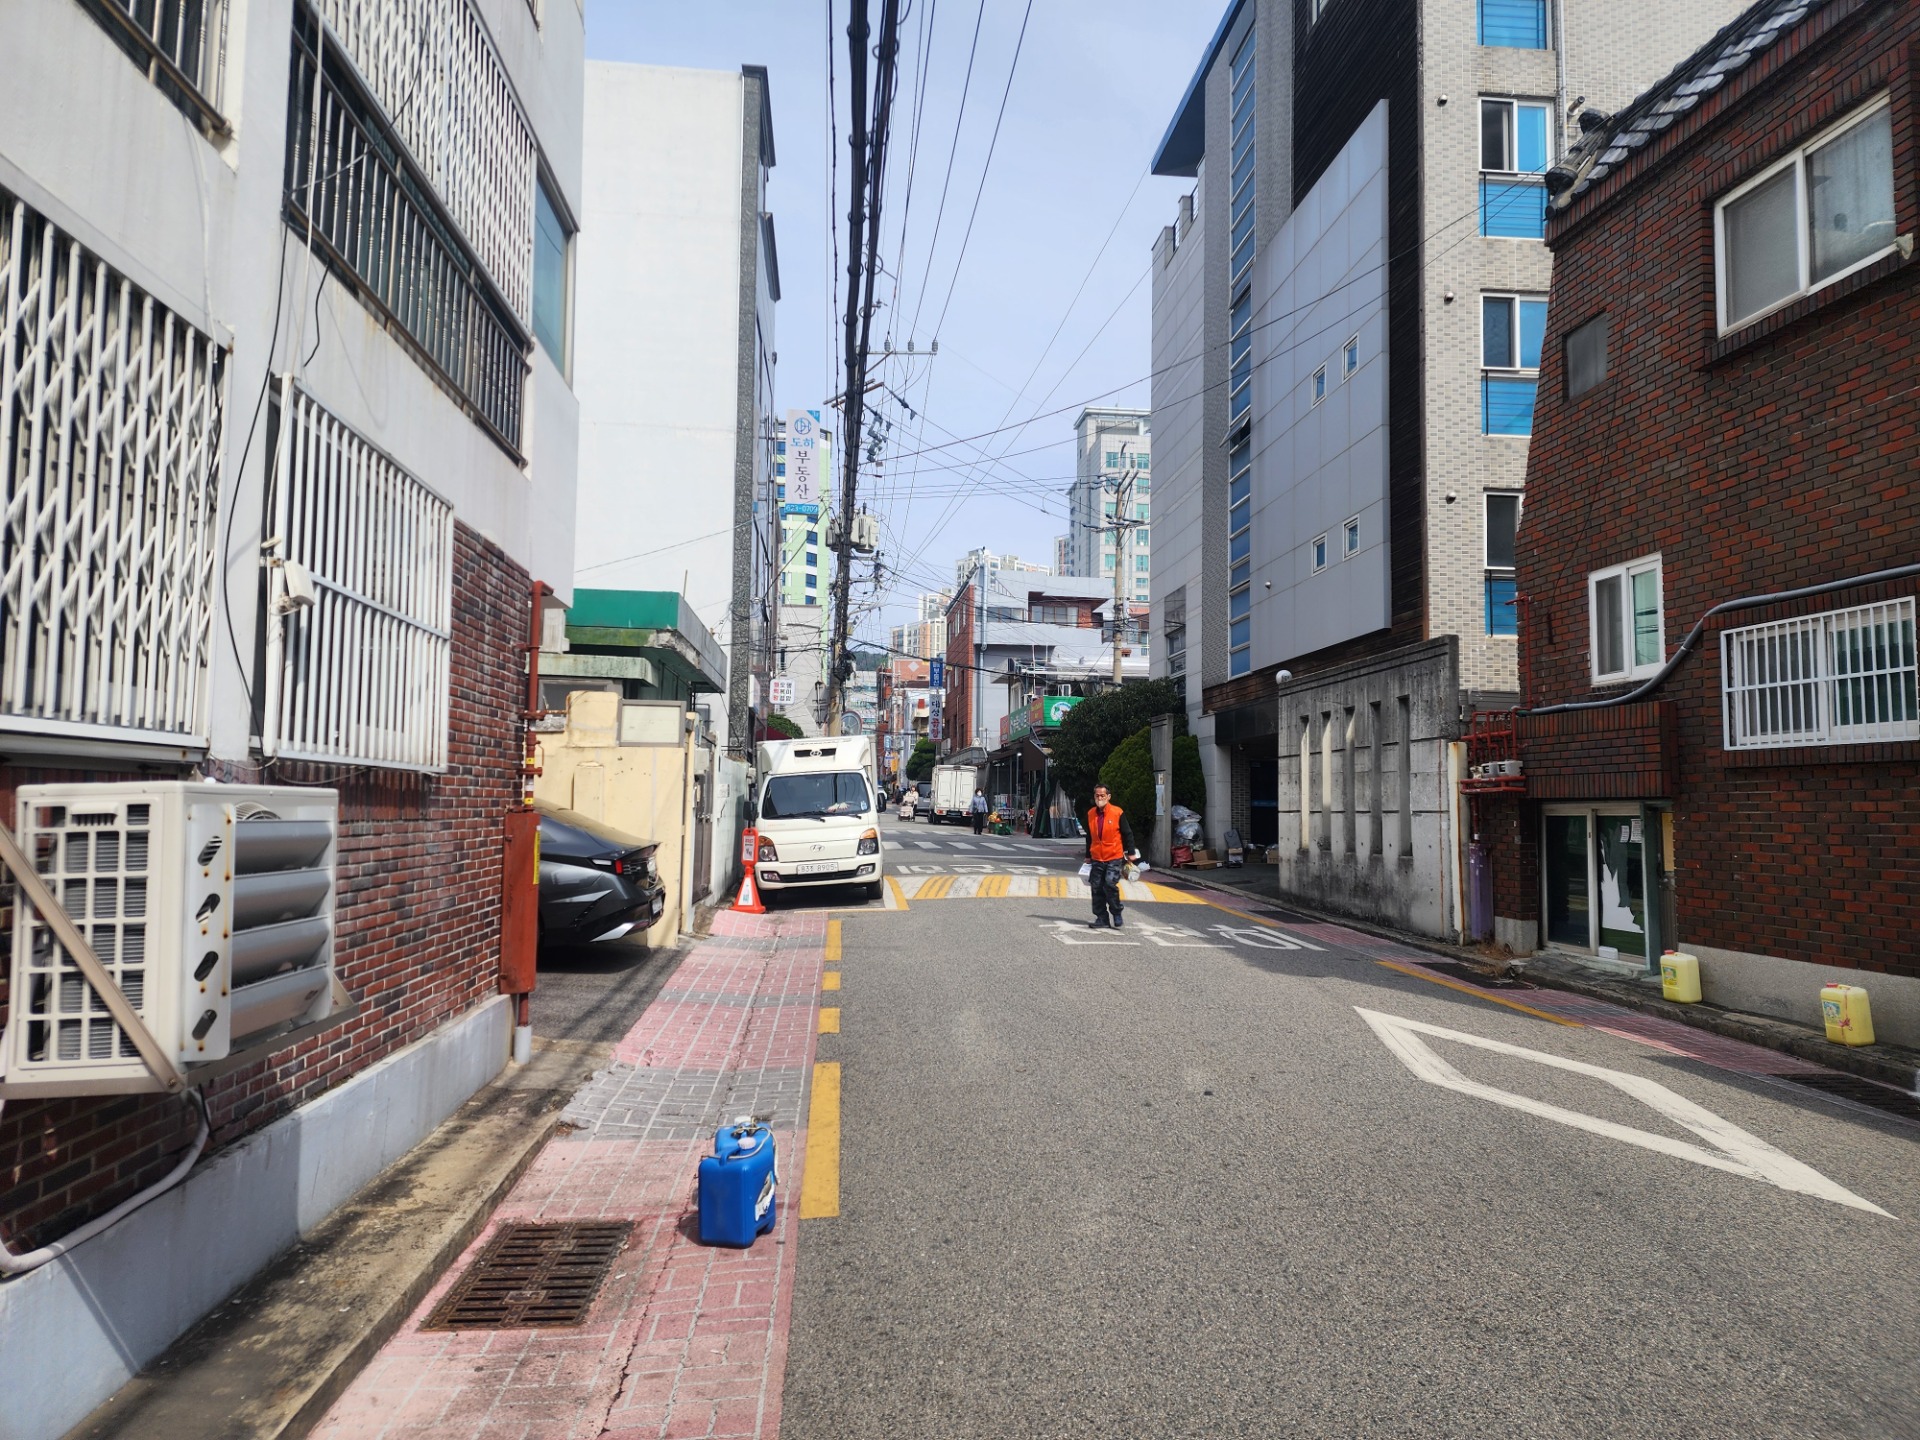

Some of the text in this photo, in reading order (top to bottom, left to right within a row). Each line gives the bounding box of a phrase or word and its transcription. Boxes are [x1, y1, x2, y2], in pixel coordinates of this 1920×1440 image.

[790, 437, 815, 449] 도하
[794, 450, 811, 500] 부동산
[1038, 920, 1330, 953] 천천히
